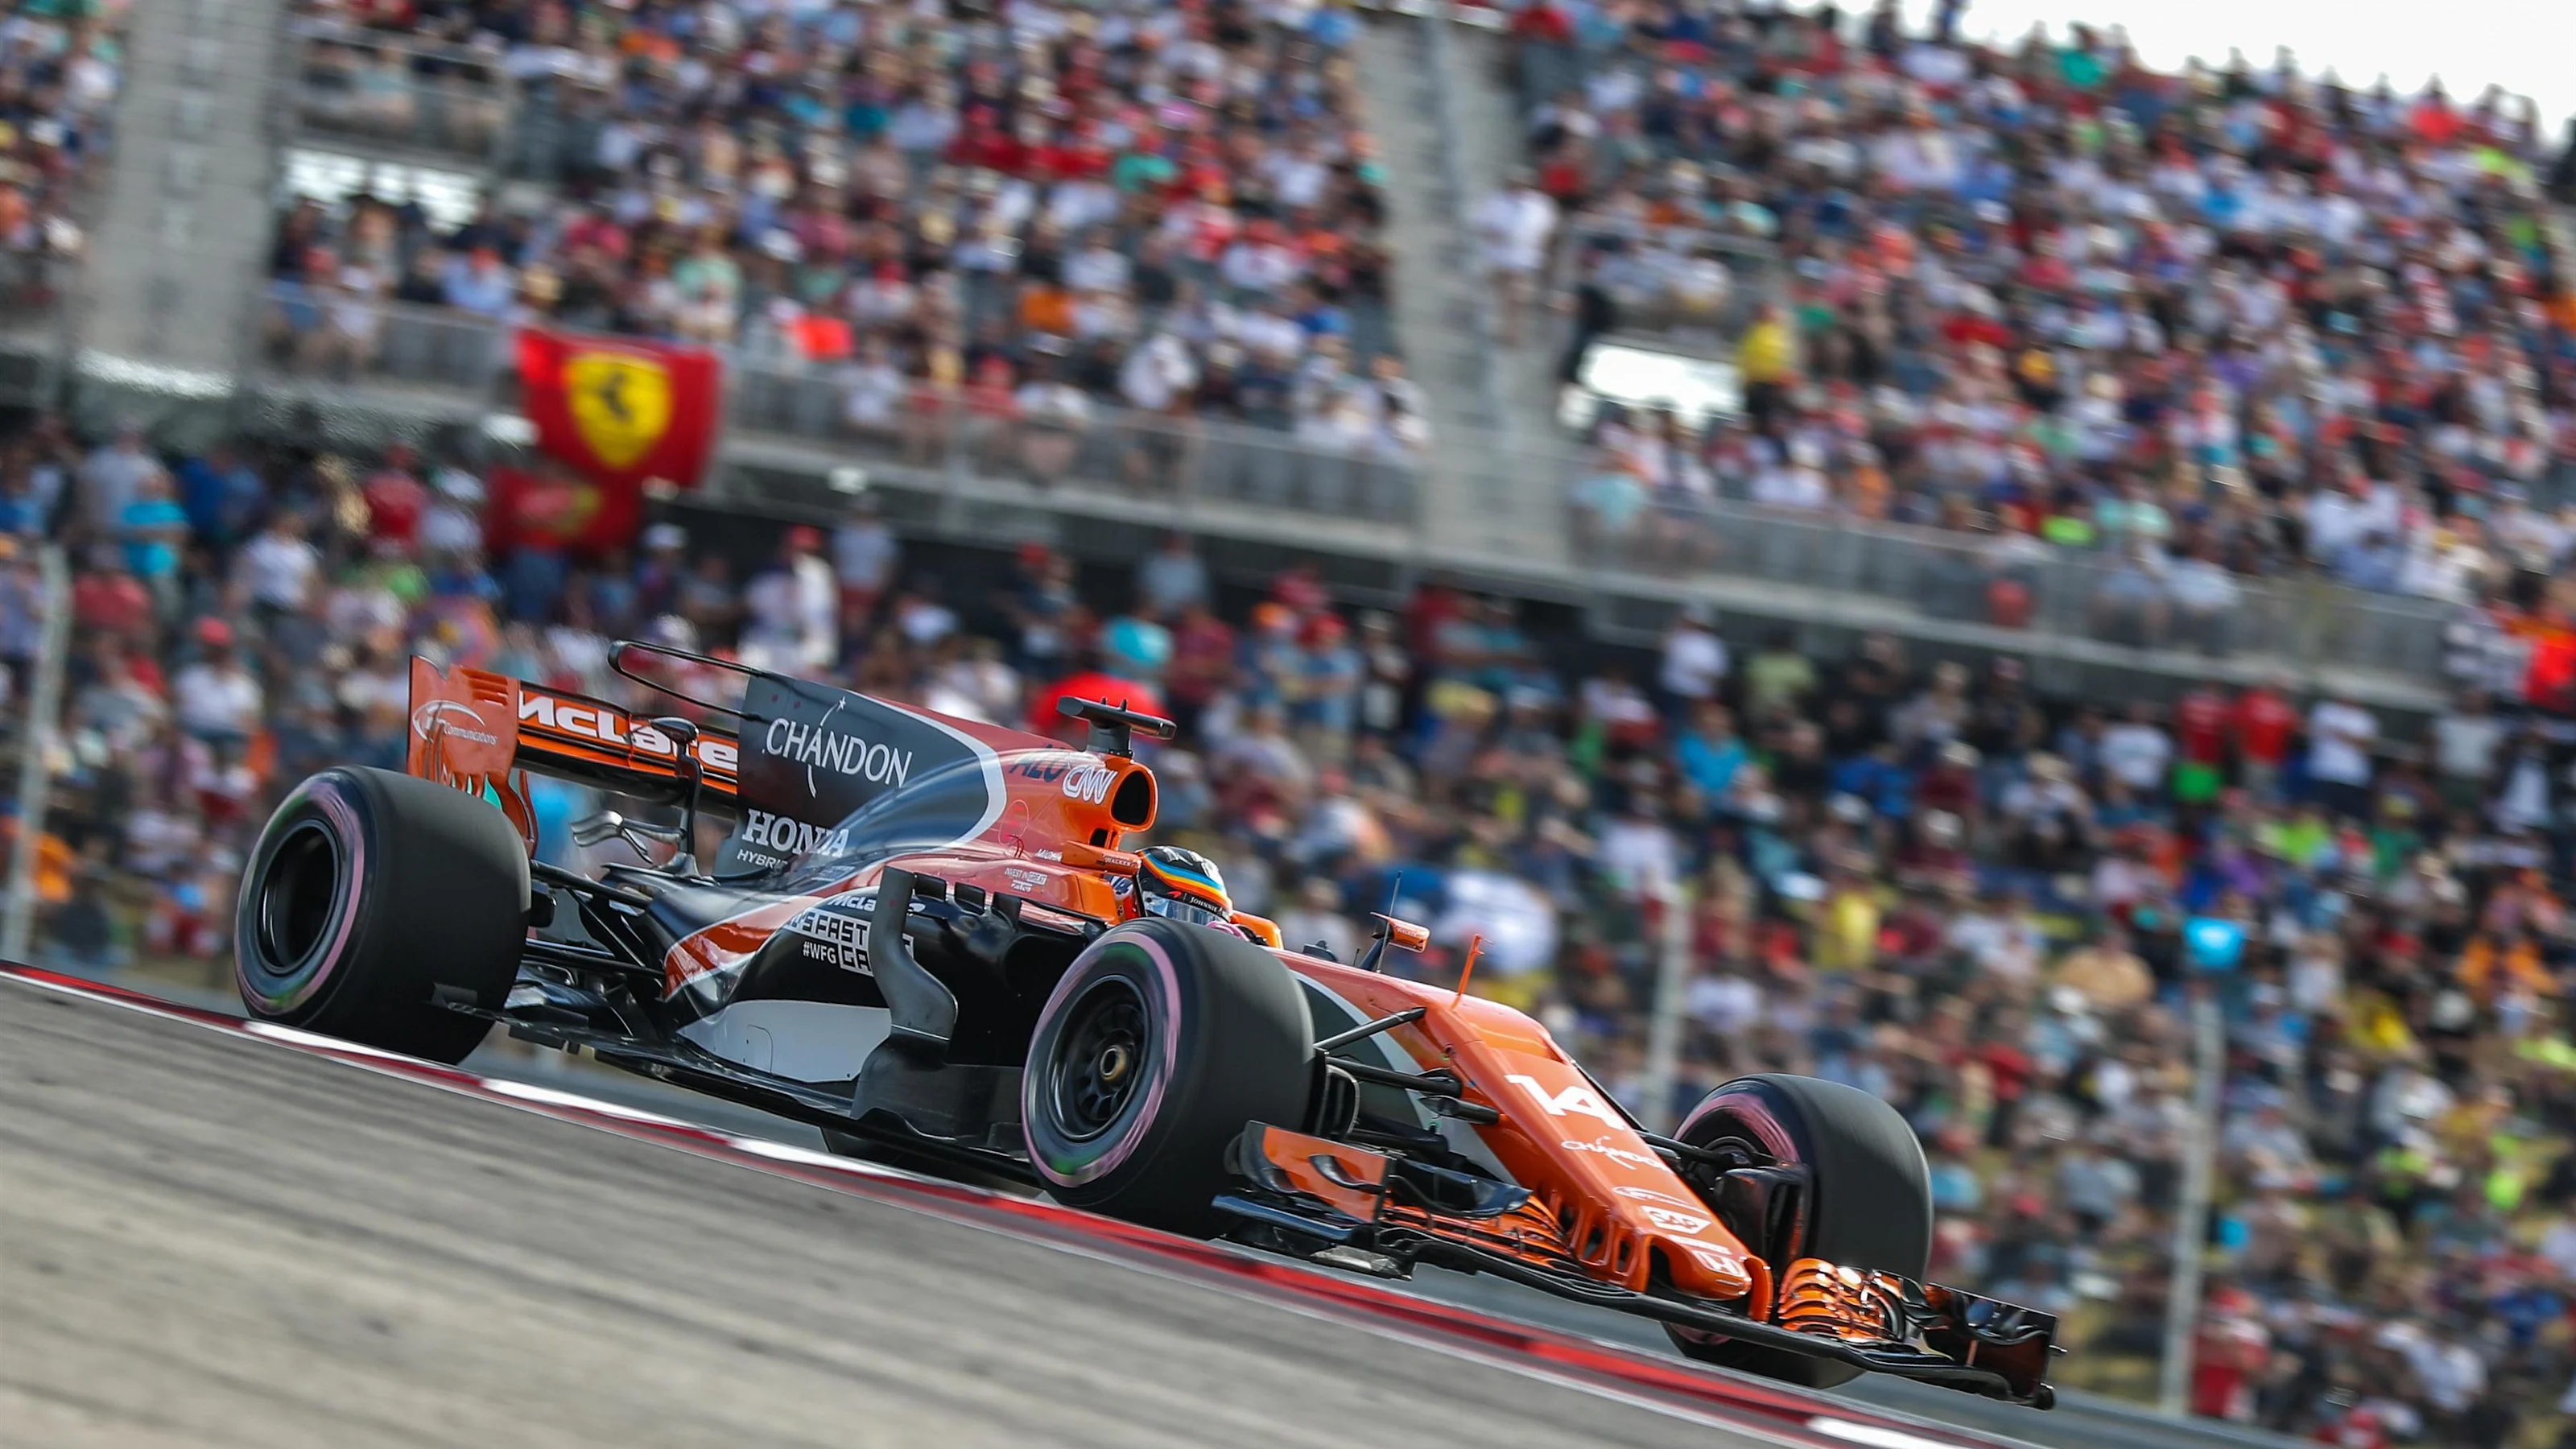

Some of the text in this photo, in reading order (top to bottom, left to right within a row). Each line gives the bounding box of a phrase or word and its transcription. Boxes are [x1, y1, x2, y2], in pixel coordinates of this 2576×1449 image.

[518, 689, 738, 771] McLae
[765, 718, 913, 787] CHANDON
[1062, 765, 1119, 805] CNN
[737, 848, 788, 872] HYBR
[828, 895, 877, 911] McLa
[815, 914, 868, 947] FAST
[803, 940, 837, 964] #WFG
[1504, 1075, 1627, 1131] 14
[1649, 1211, 1699, 1229] SAP
